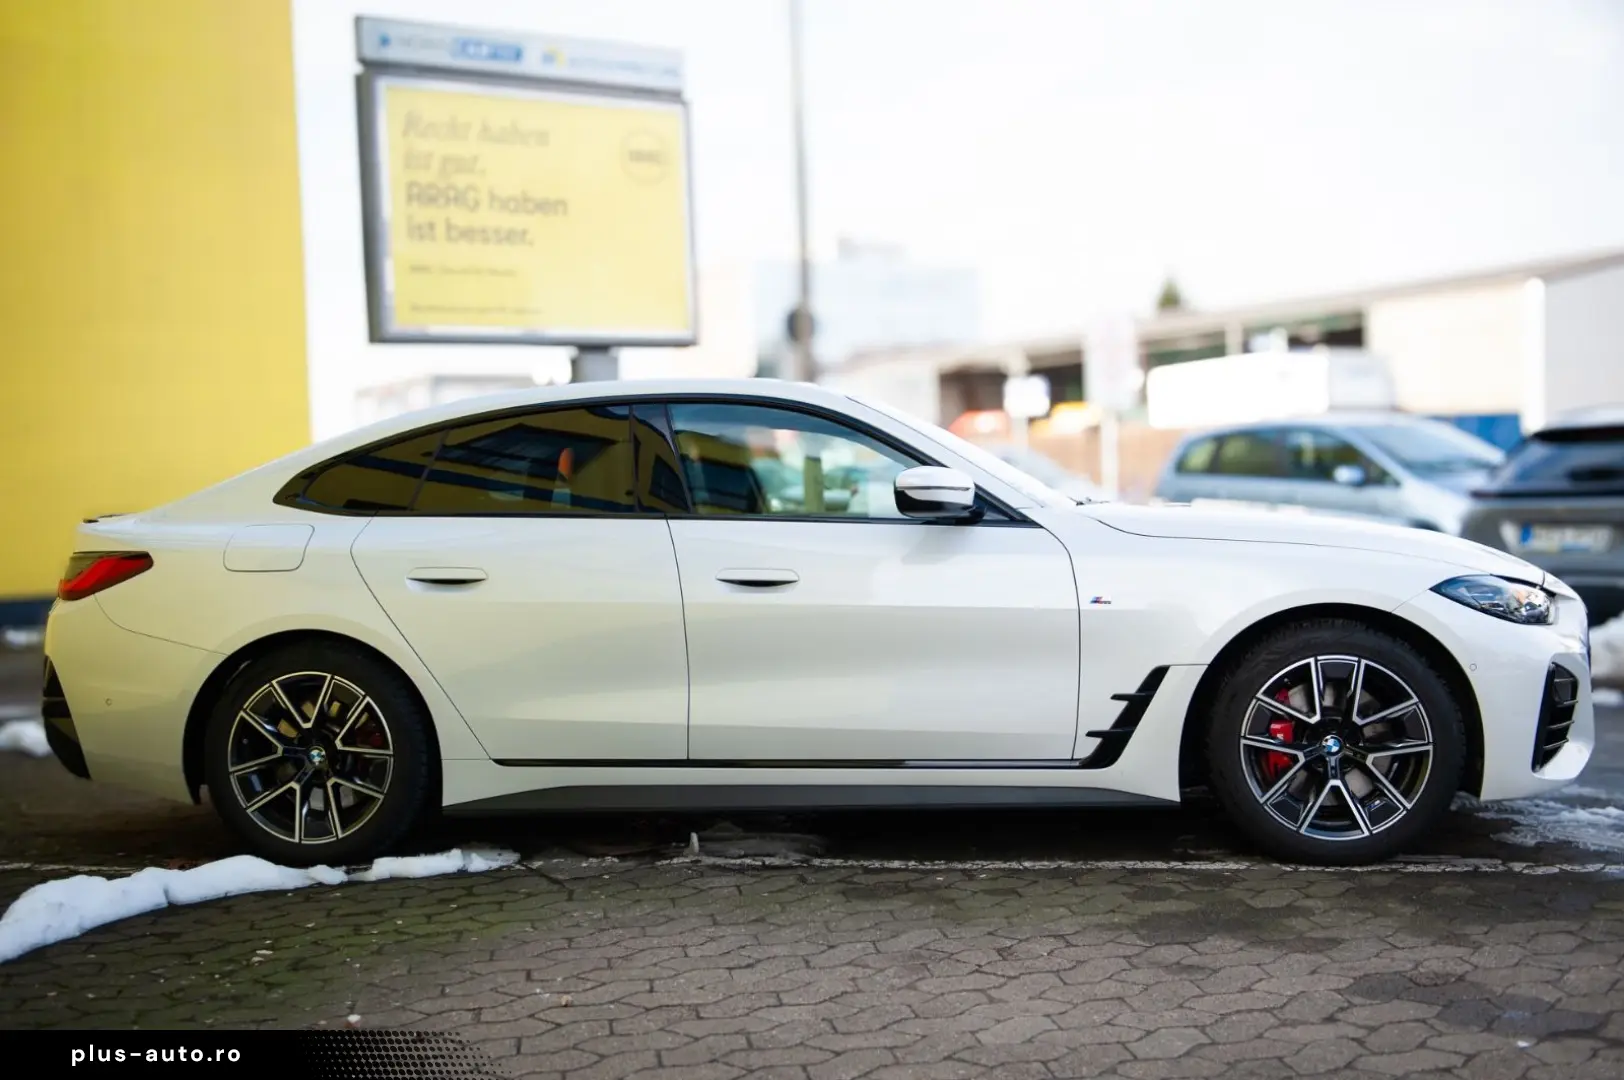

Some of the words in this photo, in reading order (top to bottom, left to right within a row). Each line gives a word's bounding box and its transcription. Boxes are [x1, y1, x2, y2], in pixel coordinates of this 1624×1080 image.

[402, 110, 471, 141] Recht
[477, 115, 550, 146] haben
[404, 148, 433, 170] ist
[406, 181, 480, 211] ARAG
[488, 187, 568, 216] haben
[406, 215, 437, 241] ist
[444, 217, 534, 247] besser.
